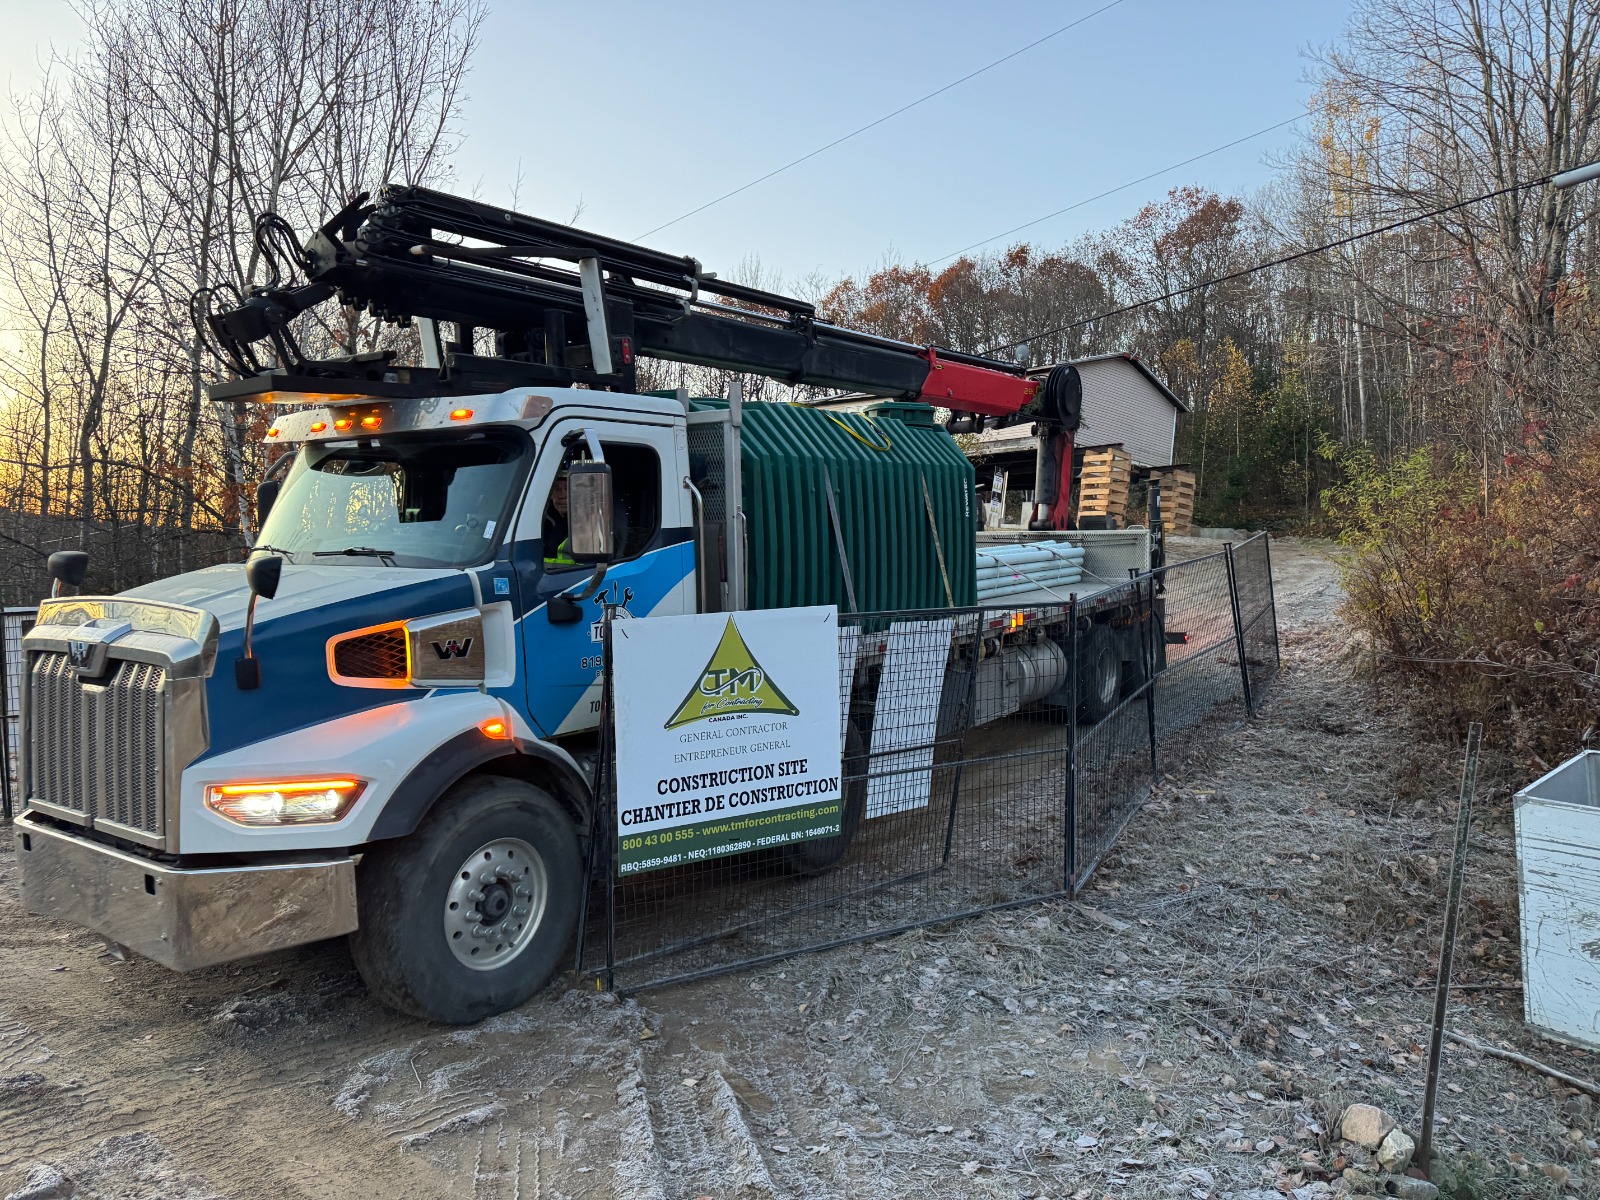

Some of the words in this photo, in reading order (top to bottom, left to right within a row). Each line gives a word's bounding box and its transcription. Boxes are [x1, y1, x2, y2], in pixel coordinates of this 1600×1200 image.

[701, 700, 715, 715] for
[716, 696, 764, 708] Contracting
[708, 715, 735, 723] CANADA
[680, 729, 724, 744] GENERAL
[726, 722, 788, 737] CONTRACTOR
[674, 745, 747, 763] ENTREPRENEUR
[750, 740, 791, 753] GENERAL
[657, 764, 774, 796] CONSTRUCTION
[778, 759, 808, 777] SITE
[621, 799, 702, 826] CHANTIER
[705, 795, 725, 812] DE
[728, 777, 839, 808] CONSTRUCTION
[622, 838, 642, 851] 800
[644, 835, 658, 846] 43
[660, 832, 673, 842] 00
[675, 828, 694, 841] 555
[702, 805, 839, 836] www.tmforcontracting.com
[621, 853, 682, 873] RBQ:5859-9481
[688, 840, 751, 860] NEQ:1180362890
[756, 833, 789, 847] FEDERAL
[791, 831, 804, 840] BN:
